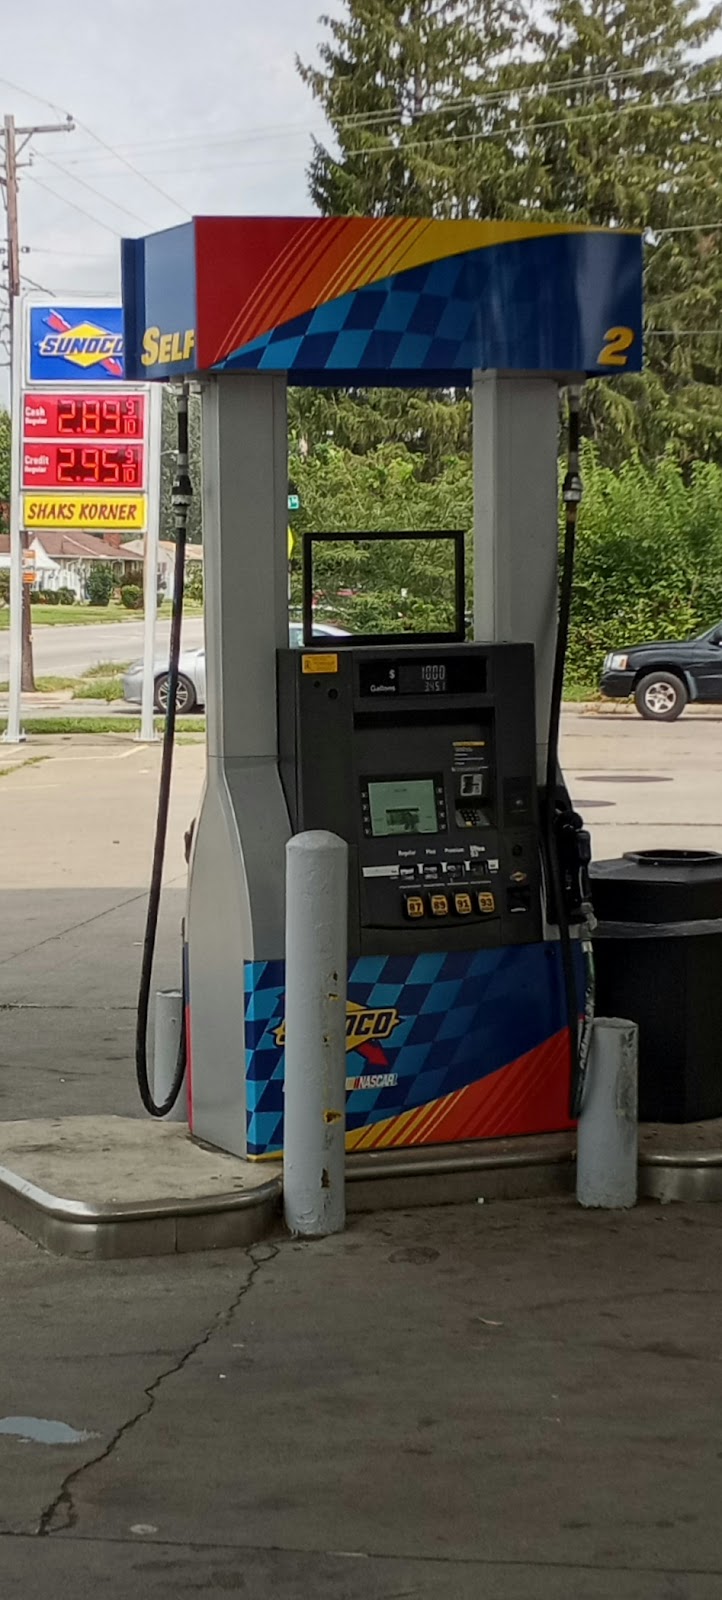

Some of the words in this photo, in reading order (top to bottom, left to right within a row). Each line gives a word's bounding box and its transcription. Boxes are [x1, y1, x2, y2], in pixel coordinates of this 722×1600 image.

[141, 326, 195, 366] SELF
[596, 326, 634, 366] 2
[25, 406, 46, 416] Cash
[25, 417, 48, 426] Regular
[58, 400, 121, 433] 2.89
[24, 455, 50, 465] Credit
[57, 448, 119, 482] 2.95
[24, 466, 47, 475] Regular
[27, 503, 76, 520] SHAKS
[79, 503, 137, 520] KORNER
[388, 668, 396, 680] $
[370, 684, 396, 693] Gallons
[409, 902, 421, 912] 87
[433, 900, 446, 910] 89
[457, 899, 469, 908] 91
[480, 898, 493, 907] 93
[358, 1073, 397, 1089] NASCAR
